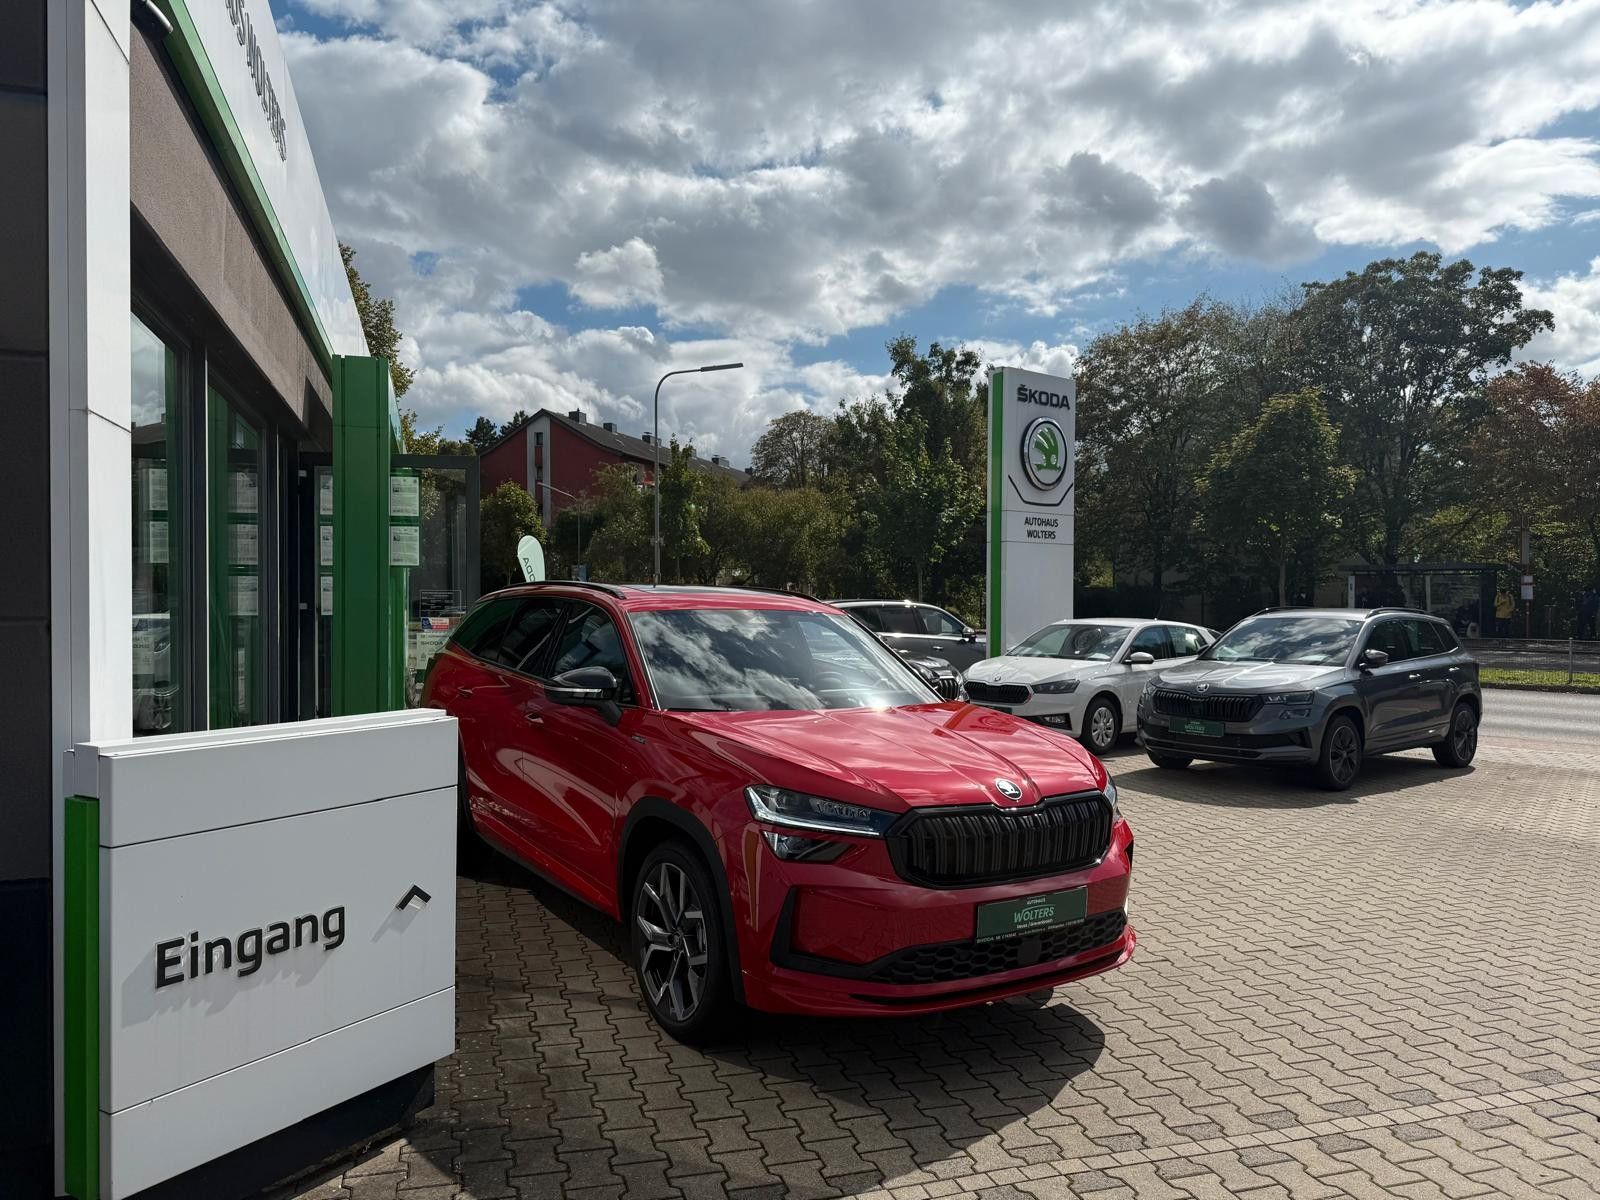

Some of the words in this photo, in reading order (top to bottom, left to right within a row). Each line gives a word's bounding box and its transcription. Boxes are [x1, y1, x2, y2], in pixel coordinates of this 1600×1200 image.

[1017, 384, 1070, 410] ŠKODA
[1024, 516, 1059, 528] AUTOHAUS
[1026, 529, 1056, 540] WOLTERS
[1014, 906, 1055, 923] WOLTERS
[155, 904, 346, 989] Eingang
